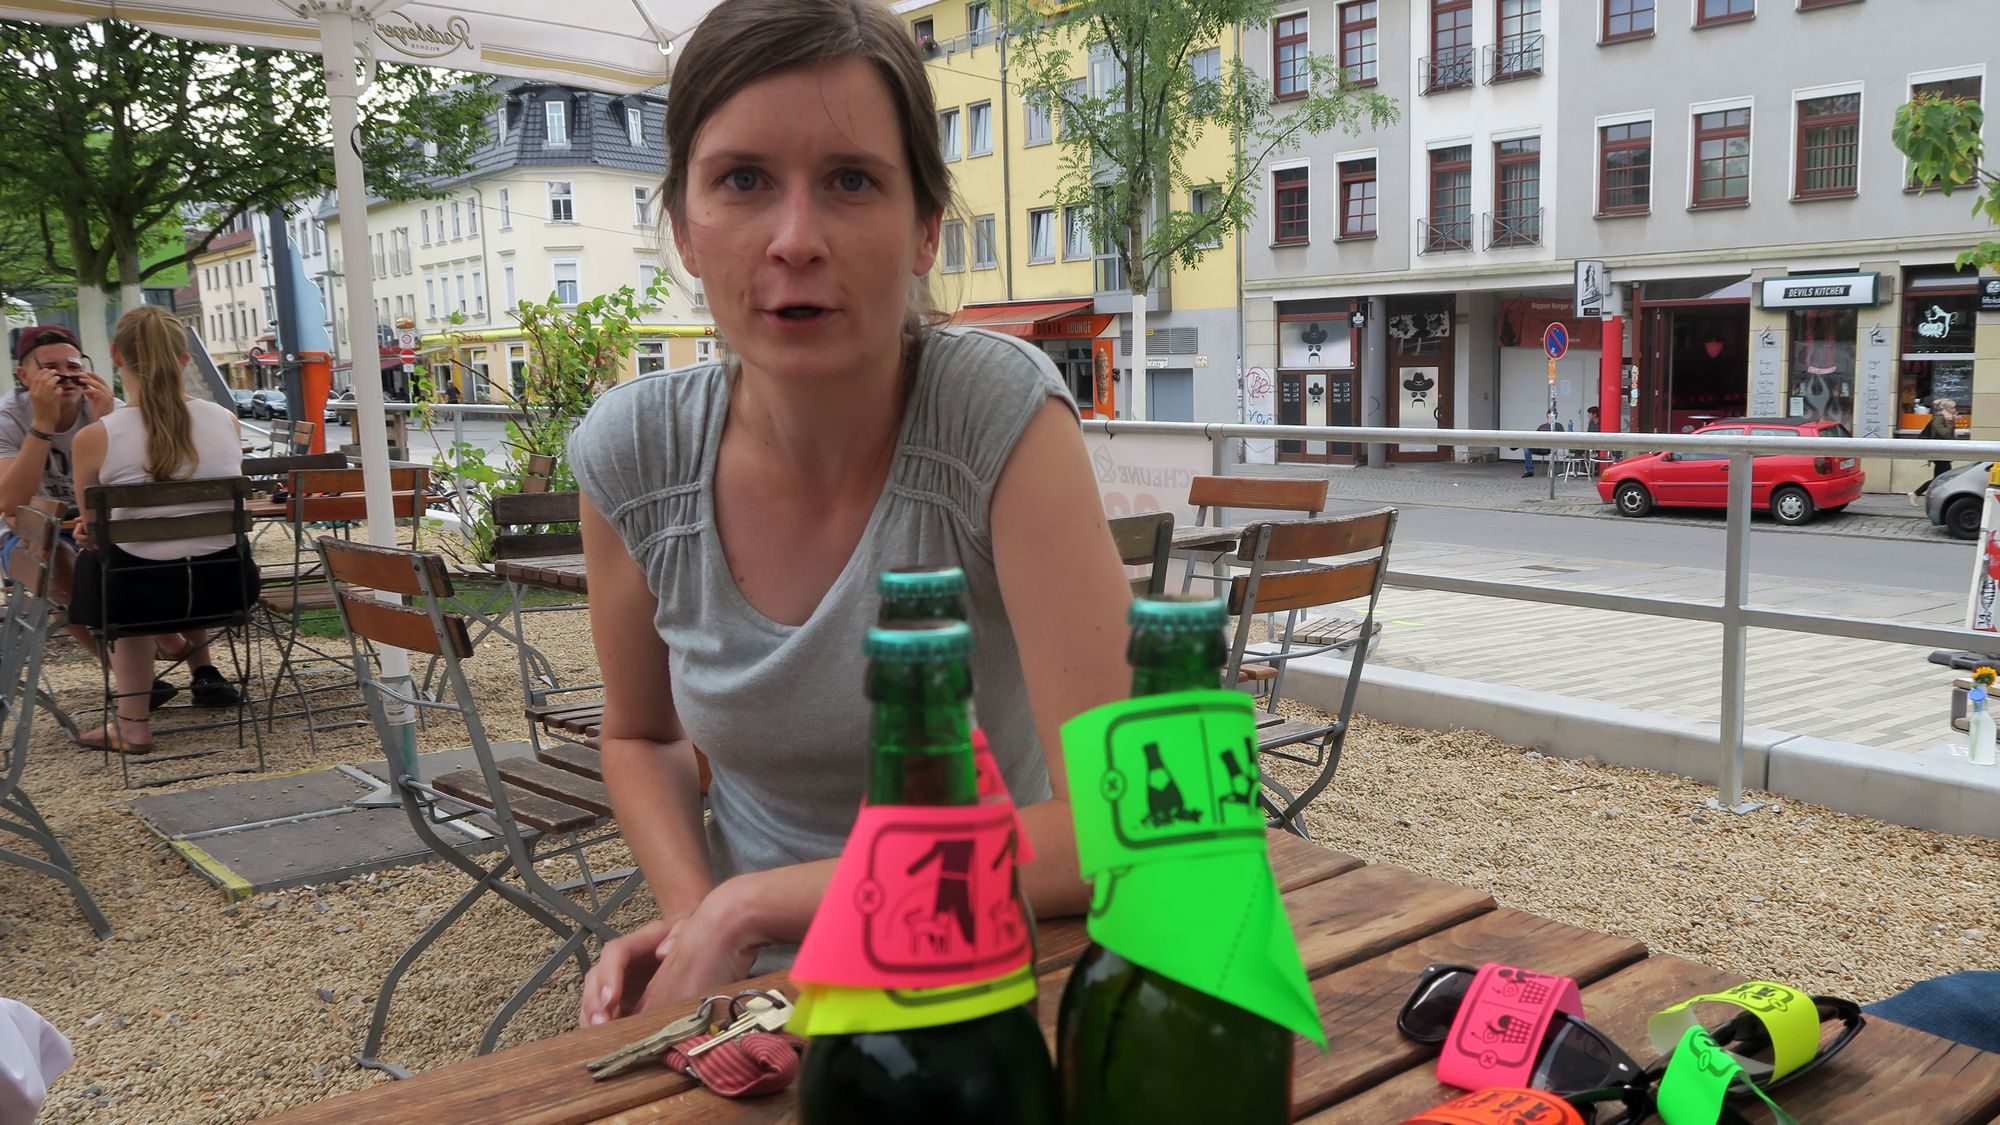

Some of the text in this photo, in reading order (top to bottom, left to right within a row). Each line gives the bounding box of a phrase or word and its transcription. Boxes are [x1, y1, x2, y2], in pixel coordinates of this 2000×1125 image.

[1788, 286, 1845, 298] DEVILS KITCHEN
[1067, 320, 1092, 335] LOUNGE
